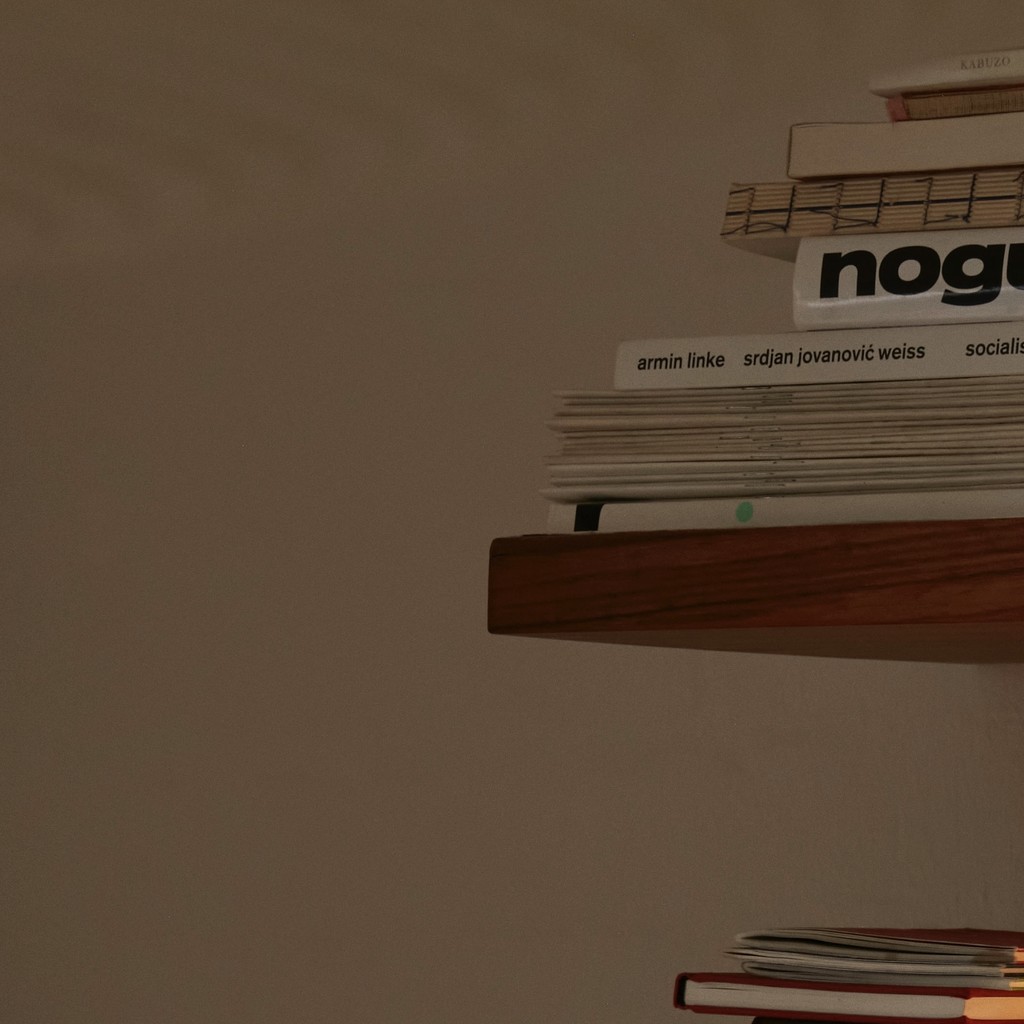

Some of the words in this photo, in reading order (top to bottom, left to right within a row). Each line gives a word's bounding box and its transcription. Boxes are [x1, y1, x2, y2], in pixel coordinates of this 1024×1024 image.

[960, 55, 1012, 71] KABUZO
[637, 353, 683, 370] armin
[687, 352, 725, 369] linke
[743, 349, 793, 369] srdjan
[797, 344, 874, 367] jovanović
[878, 342, 926, 360] weiss
